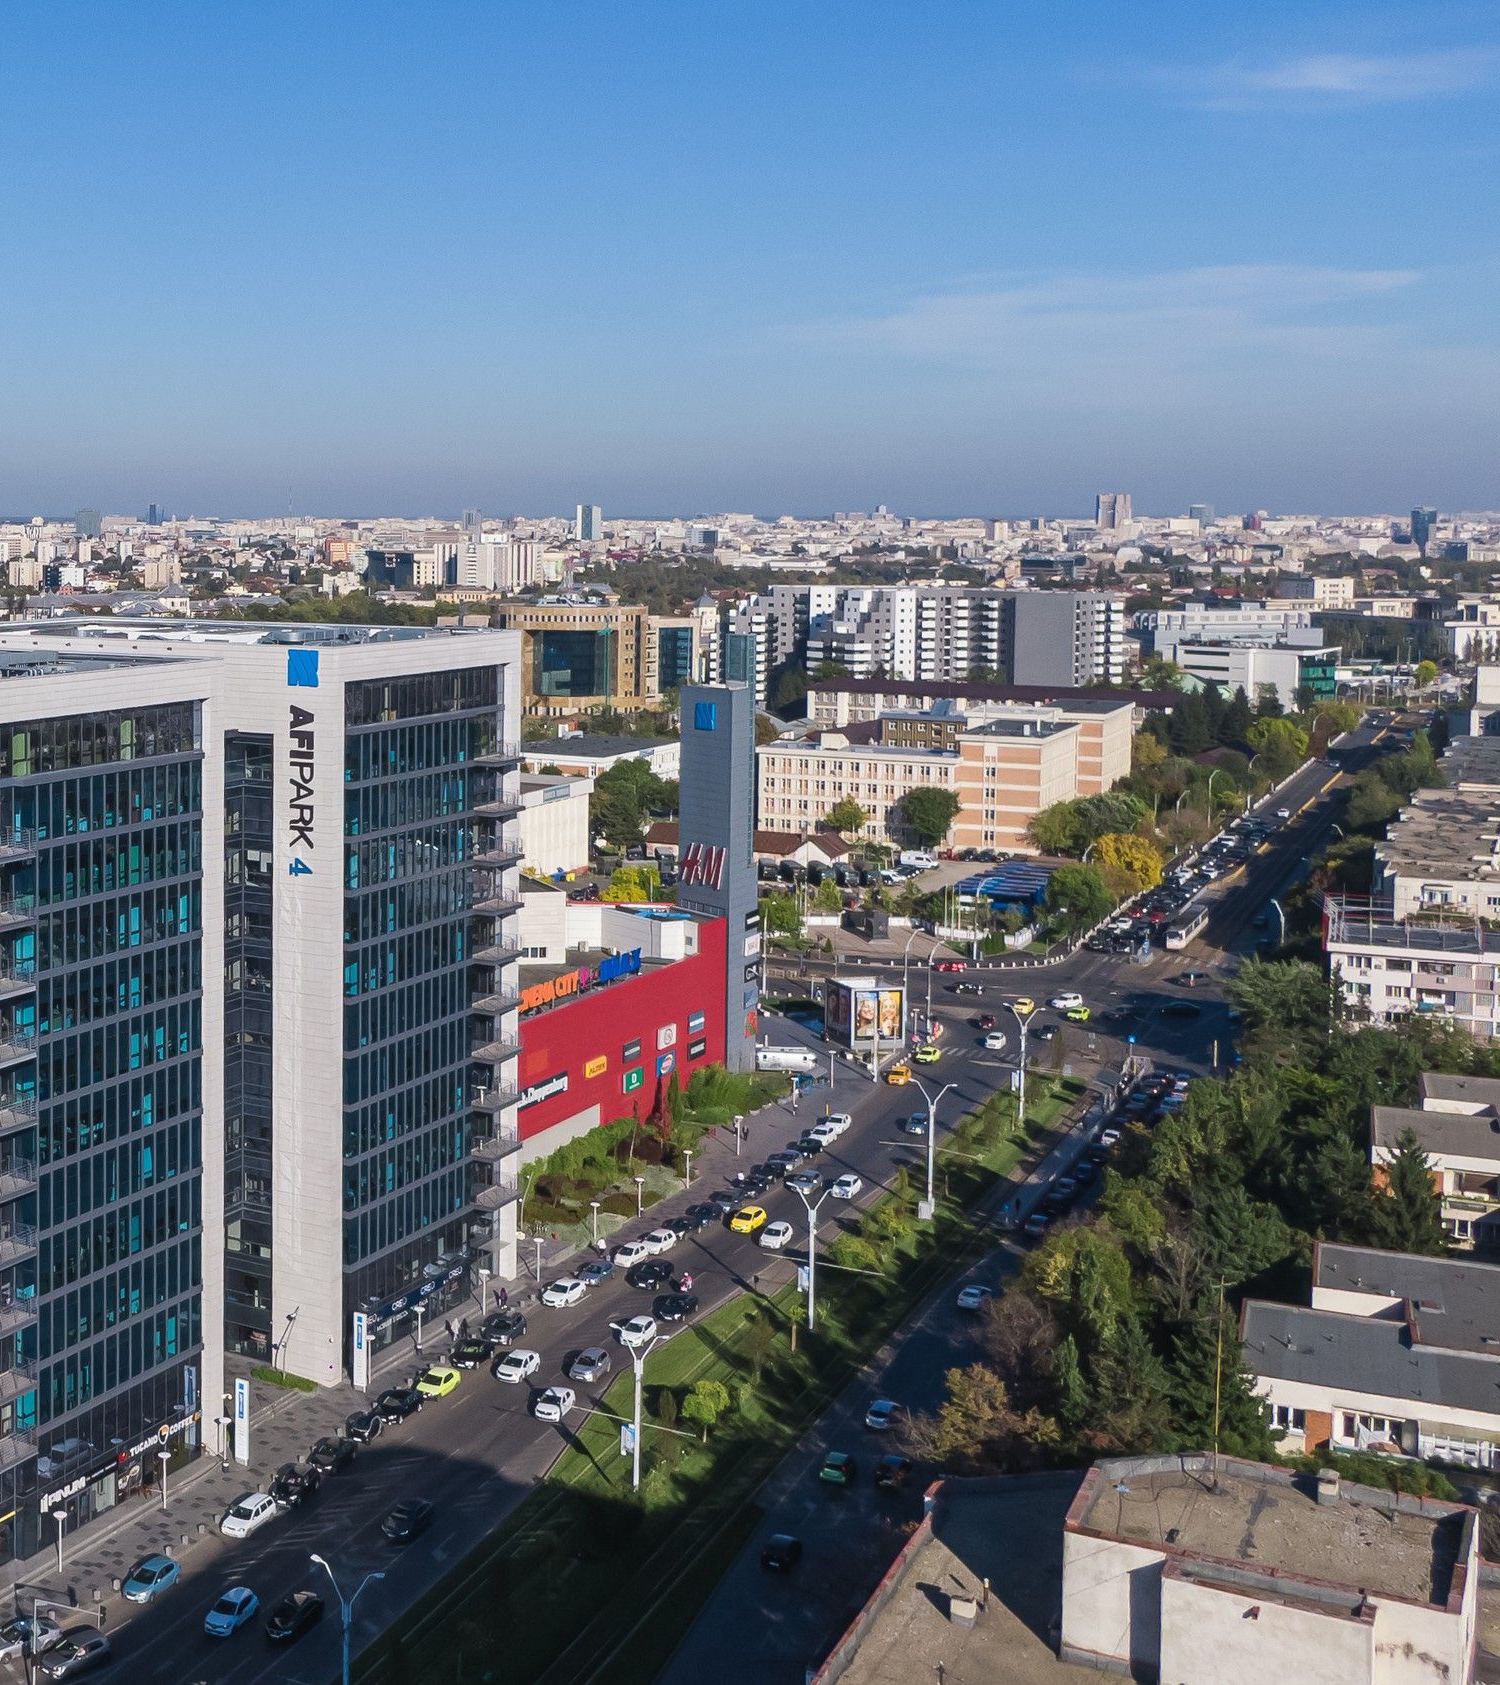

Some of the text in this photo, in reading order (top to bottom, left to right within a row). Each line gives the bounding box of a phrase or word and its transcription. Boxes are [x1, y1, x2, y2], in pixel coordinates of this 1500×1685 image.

[289, 704, 314, 877] AFIPARK 4
[129, 1435, 158, 1457] TUCANO
